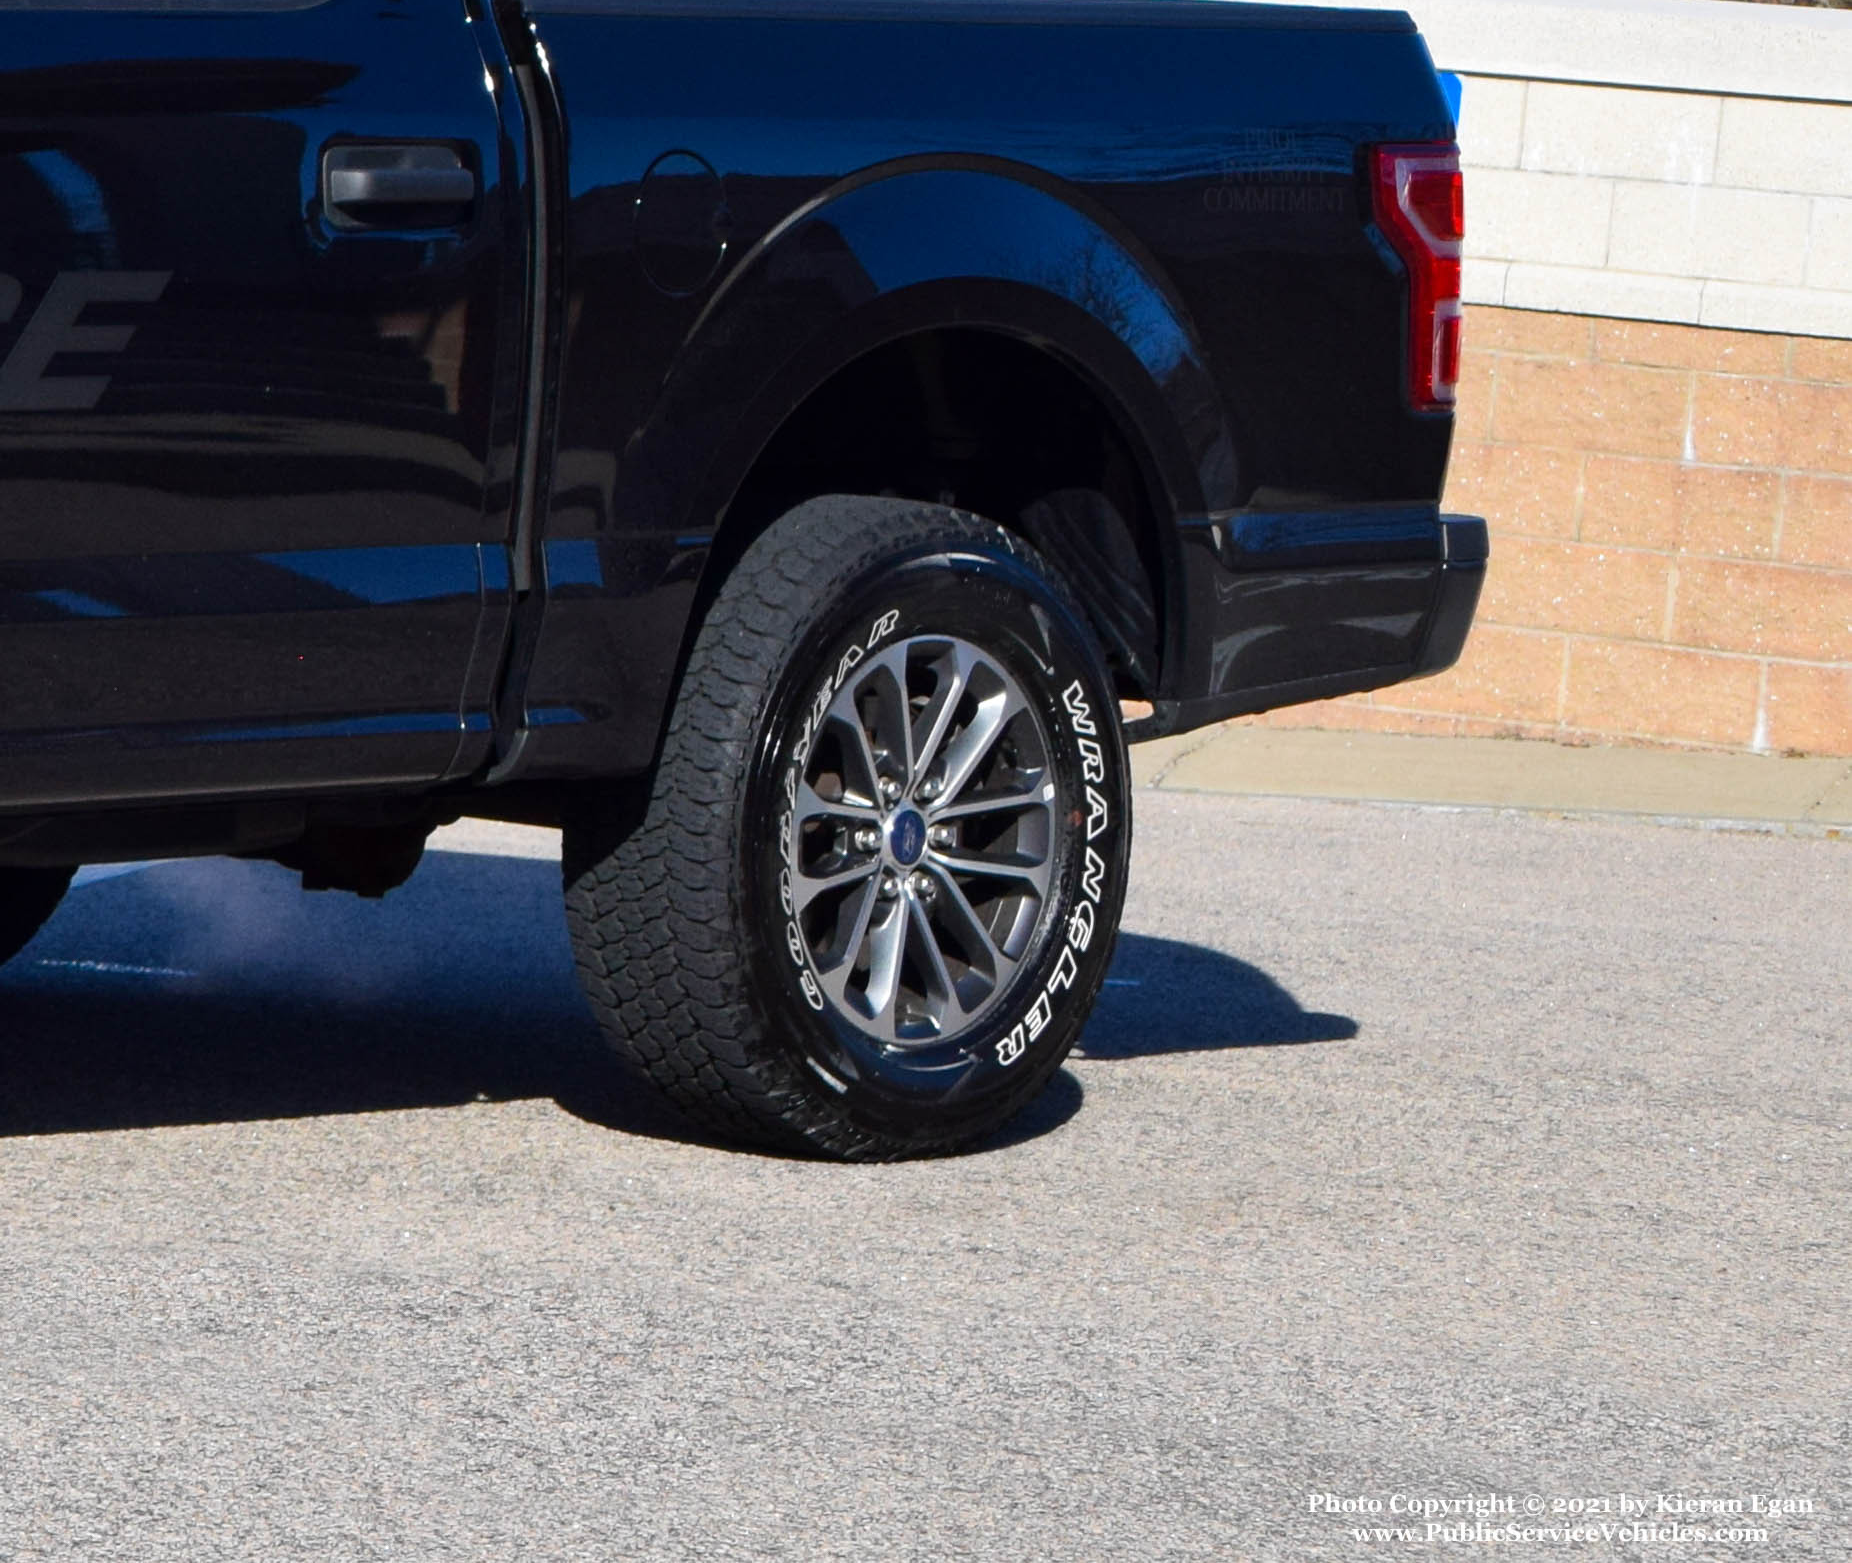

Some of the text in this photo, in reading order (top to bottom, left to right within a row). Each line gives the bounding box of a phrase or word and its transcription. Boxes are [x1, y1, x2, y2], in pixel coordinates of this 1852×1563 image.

[1203, 186, 1345, 214] COMMITMENT
[780, 609, 899, 1011] GOODYEAR
[996, 680, 1106, 1065] WRANGLER
